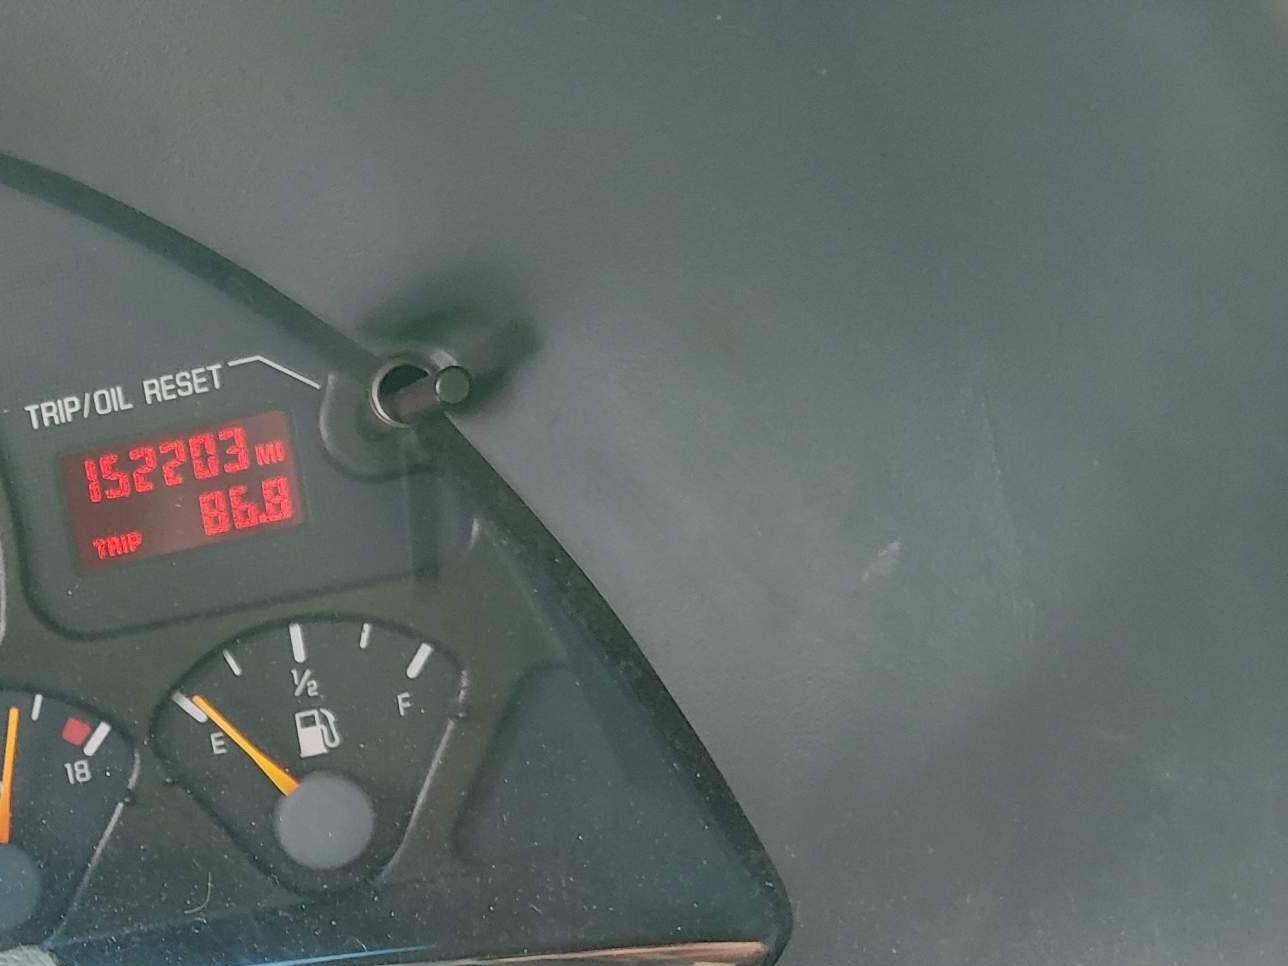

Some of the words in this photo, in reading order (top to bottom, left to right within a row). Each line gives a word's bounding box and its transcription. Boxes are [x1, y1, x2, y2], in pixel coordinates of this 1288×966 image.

[24, 386, 133, 429] TRIP/OIL
[143, 364, 221, 404] RESET
[83, 427, 250, 503] 152203
[255, 442, 285, 466] MI
[199, 476, 292, 537] 86.8
[91, 530, 144, 560] TRIP
[398, 692, 411, 715] F
[211, 731, 227, 756] E
[64, 760, 91, 784] 18
